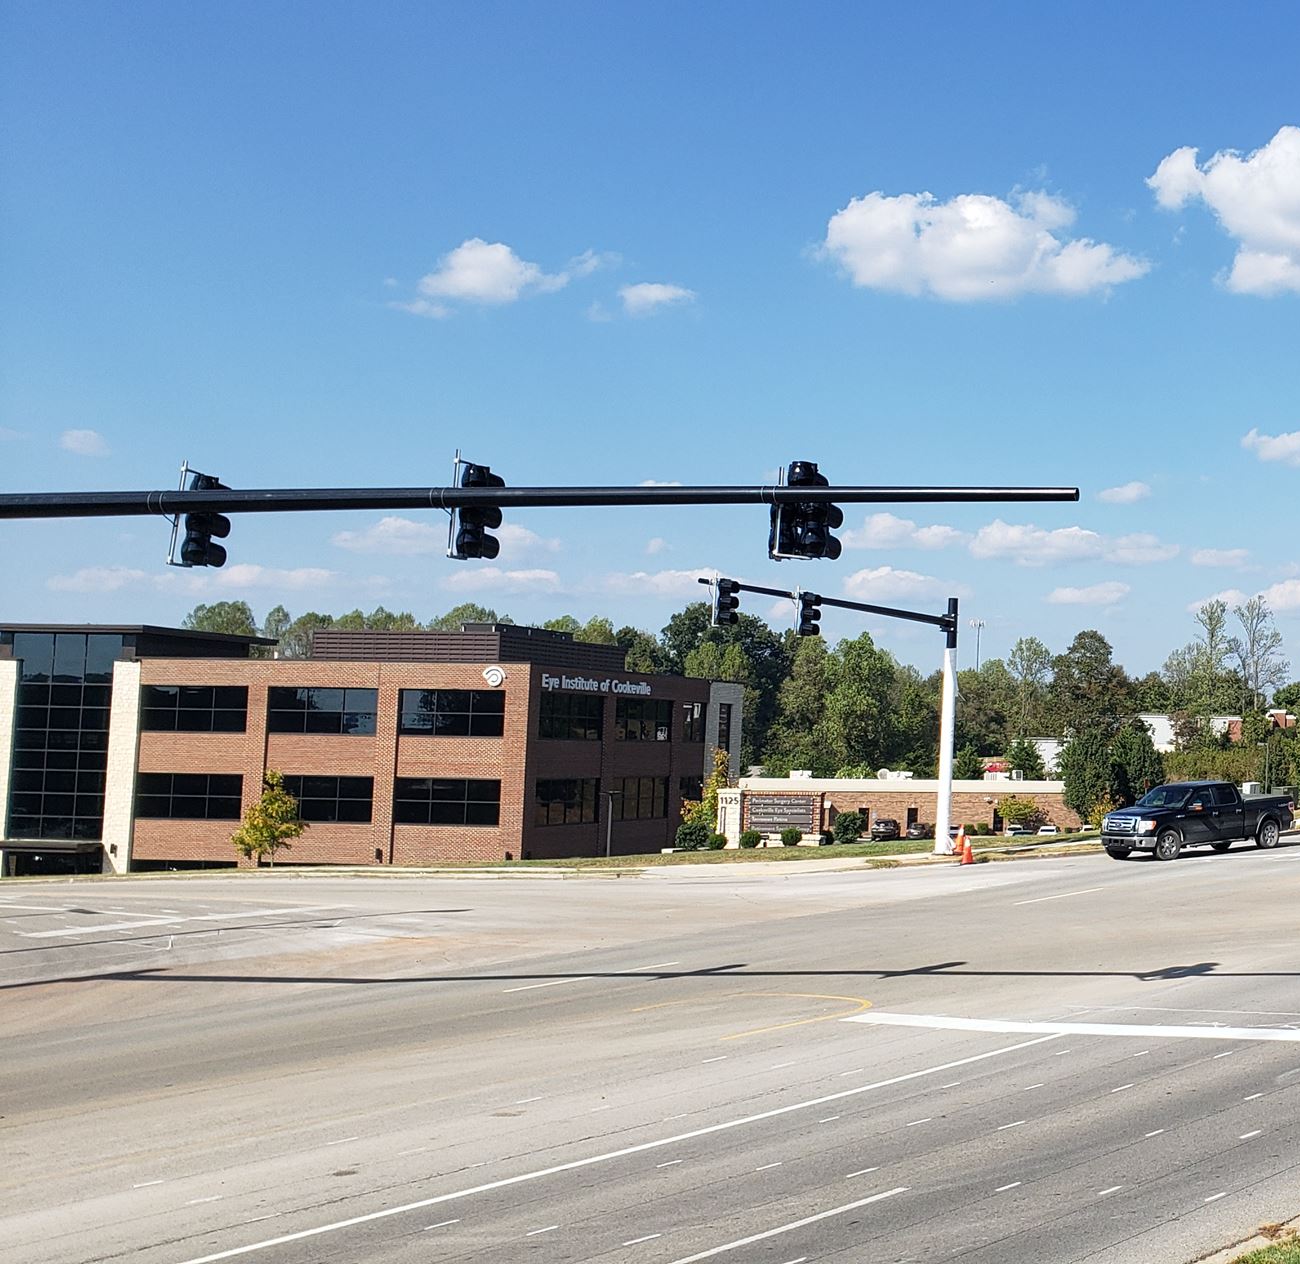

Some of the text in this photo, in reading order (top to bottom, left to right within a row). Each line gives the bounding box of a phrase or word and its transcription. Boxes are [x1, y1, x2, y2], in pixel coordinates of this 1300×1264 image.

[541, 673, 652, 696] Eye Institute of Cookeville
[720, 797, 739, 805] 1125
